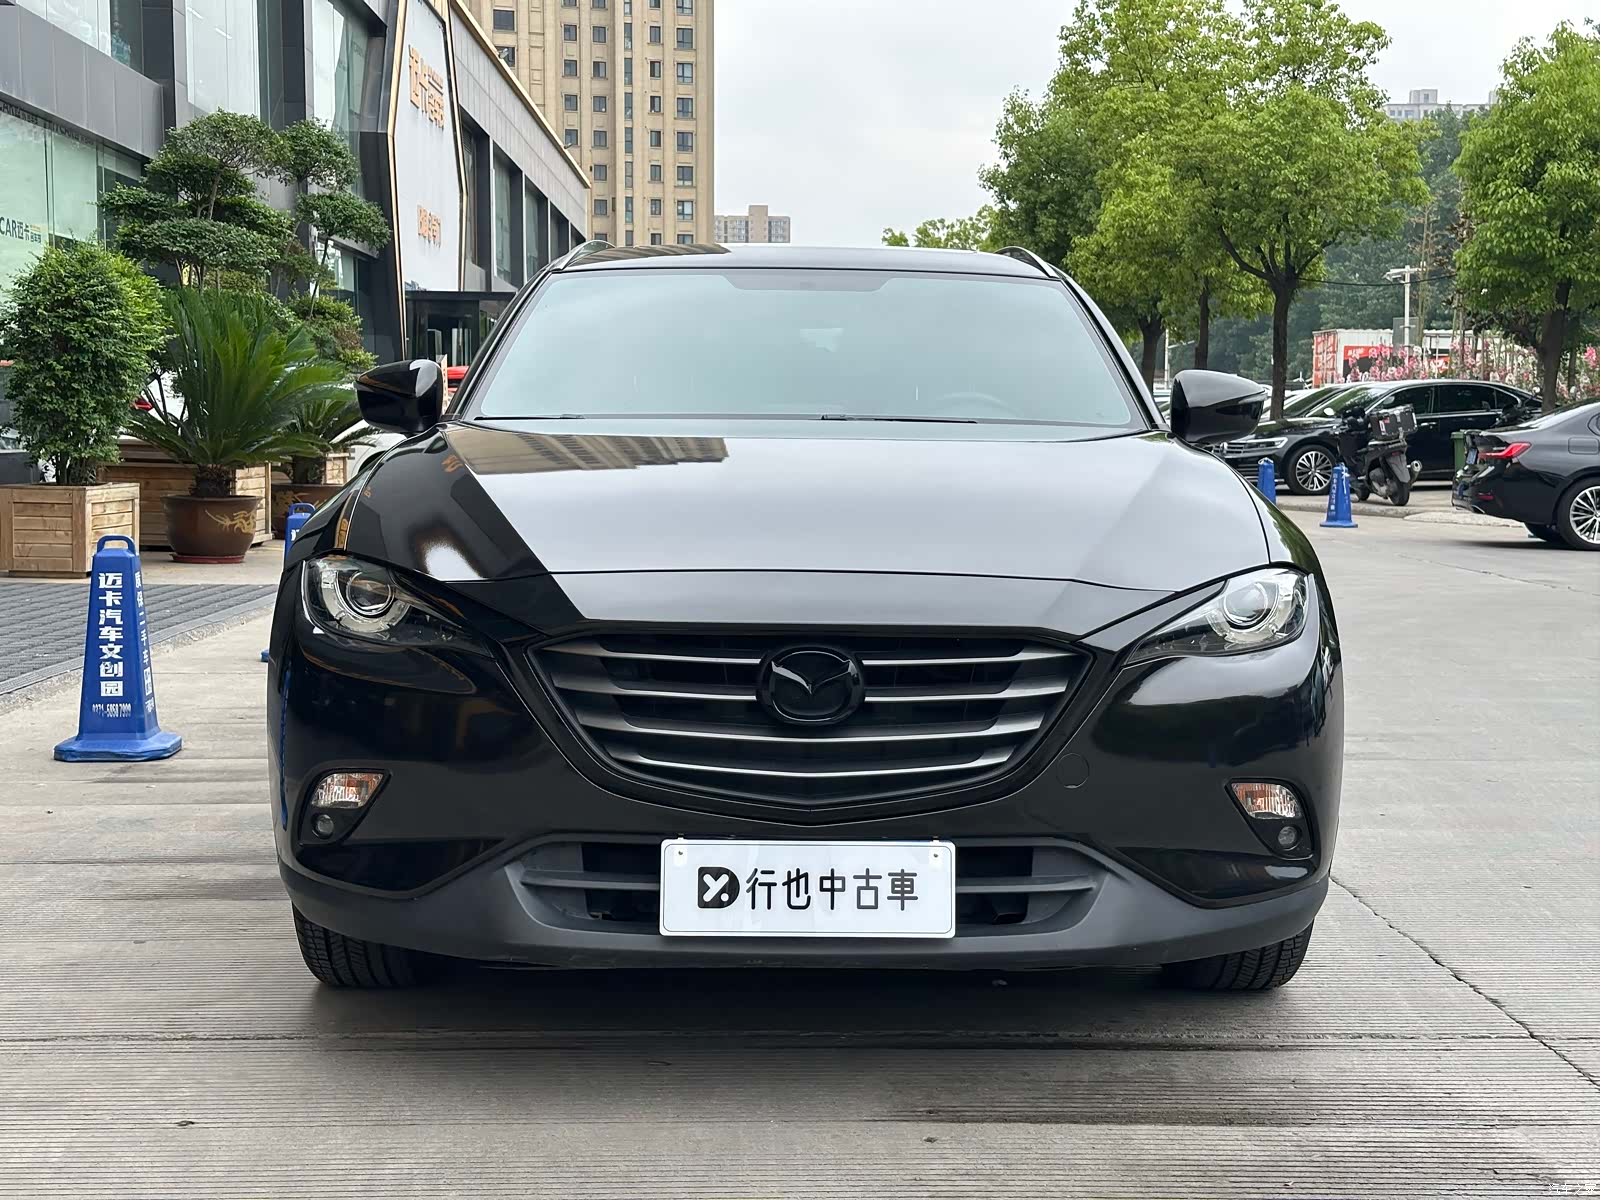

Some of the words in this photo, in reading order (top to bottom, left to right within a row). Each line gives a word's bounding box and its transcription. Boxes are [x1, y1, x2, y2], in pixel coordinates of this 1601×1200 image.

[98, 572, 124, 697] 迈卡汽车文创园
[746, 867, 919, 911] 行也中古車
